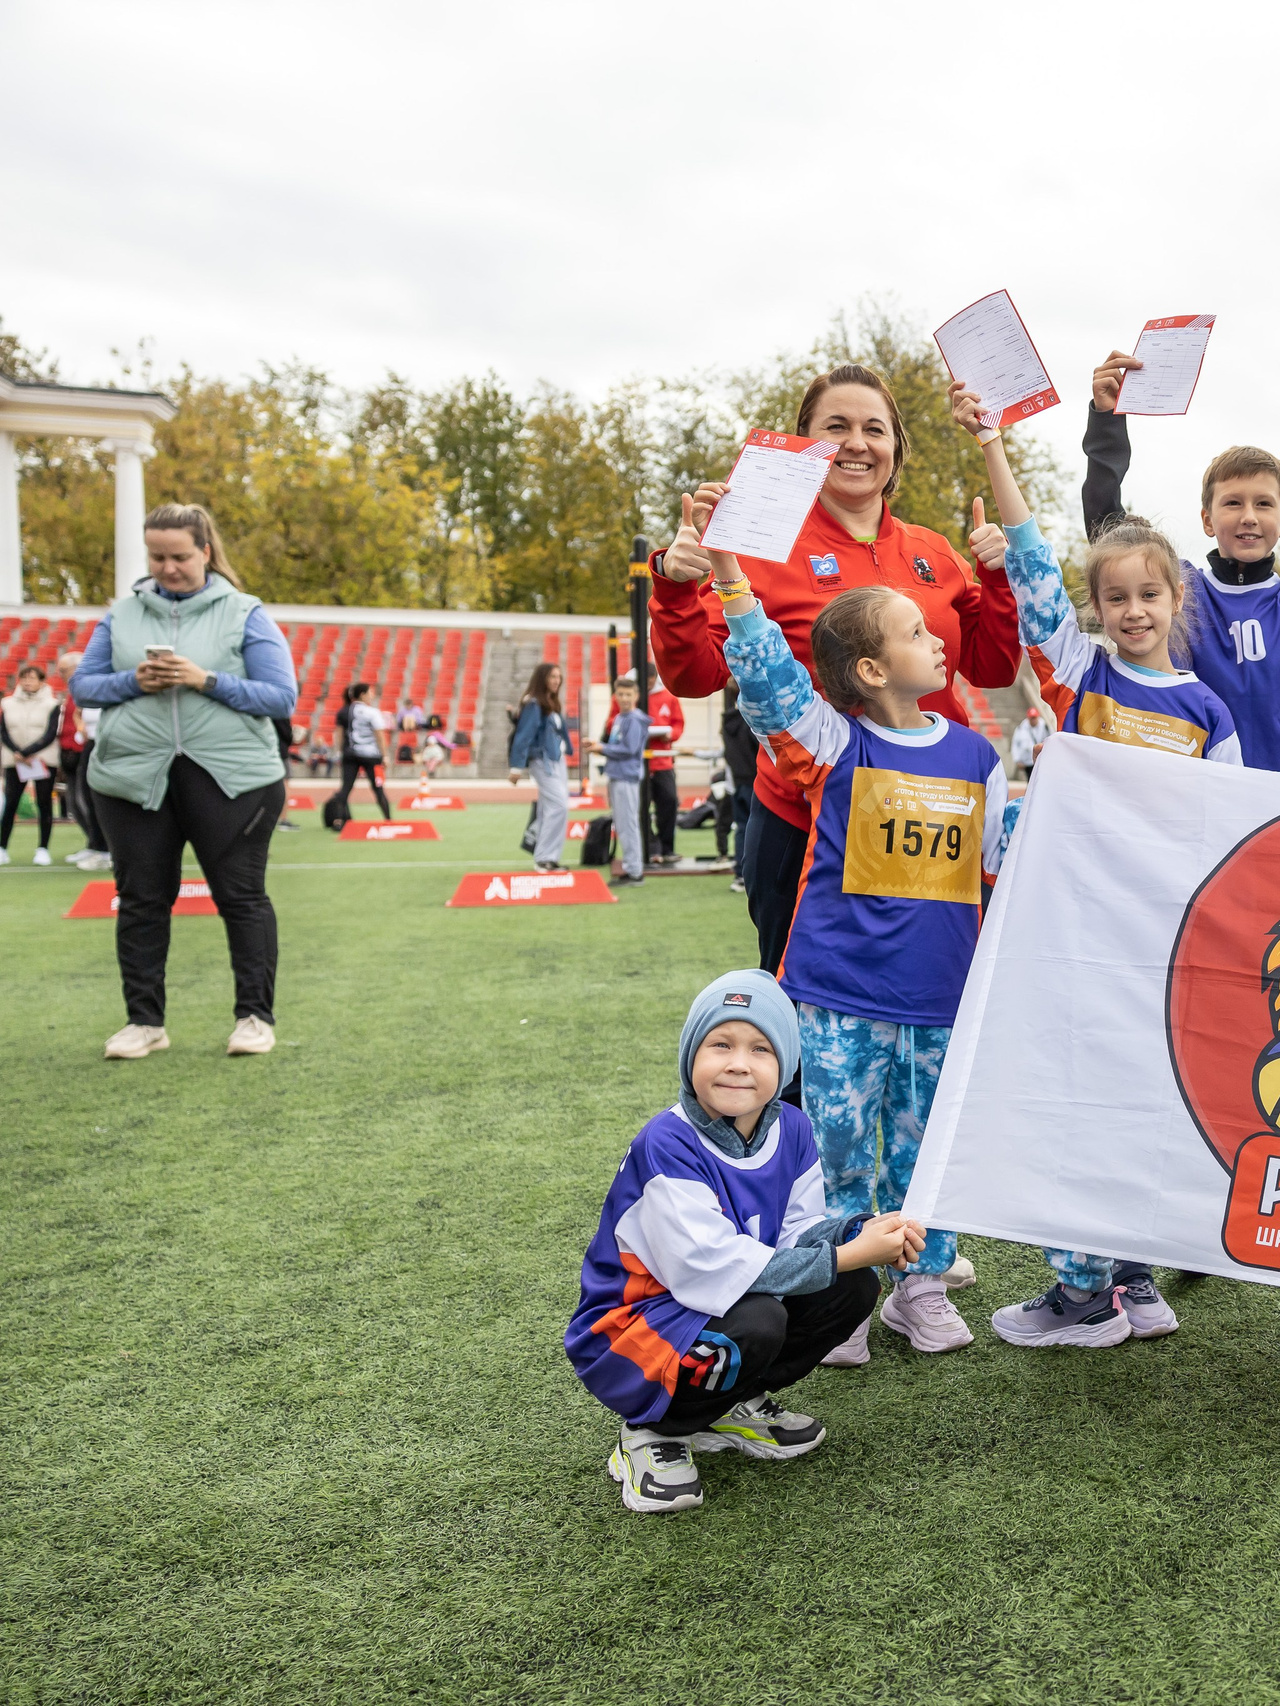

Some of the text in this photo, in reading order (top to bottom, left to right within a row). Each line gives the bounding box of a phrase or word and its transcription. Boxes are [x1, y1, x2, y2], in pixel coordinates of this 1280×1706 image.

[1228, 619, 1266, 664] 10
[1136, 723, 1155, 733] ТРУДУ
[879, 818, 962, 861] 1579
